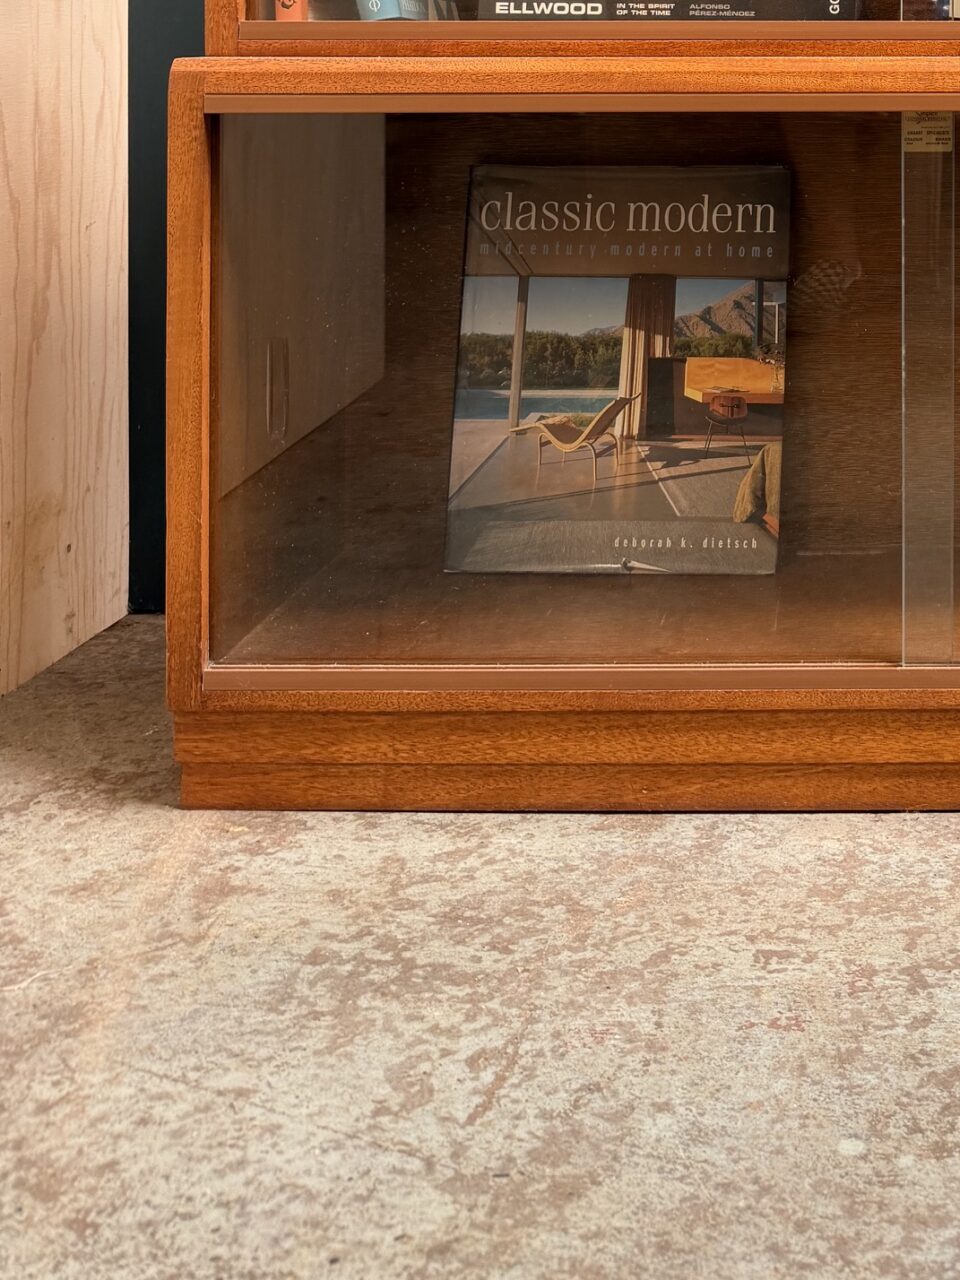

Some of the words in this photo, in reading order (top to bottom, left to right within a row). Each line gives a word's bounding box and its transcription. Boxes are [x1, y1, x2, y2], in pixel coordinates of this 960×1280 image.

[495, 2, 603, 15] ELLWOOD
[480, 192, 615, 232] classic
[626, 194, 776, 233] modern
[479, 241, 597, 259] midcentury
[610, 243, 682, 257] modern
[694, 243, 713, 257] at
[726, 243, 774, 258] home
[614, 536, 672, 549] deborah
[680, 537, 693, 549] k.
[702, 537, 758, 549] dietsch
